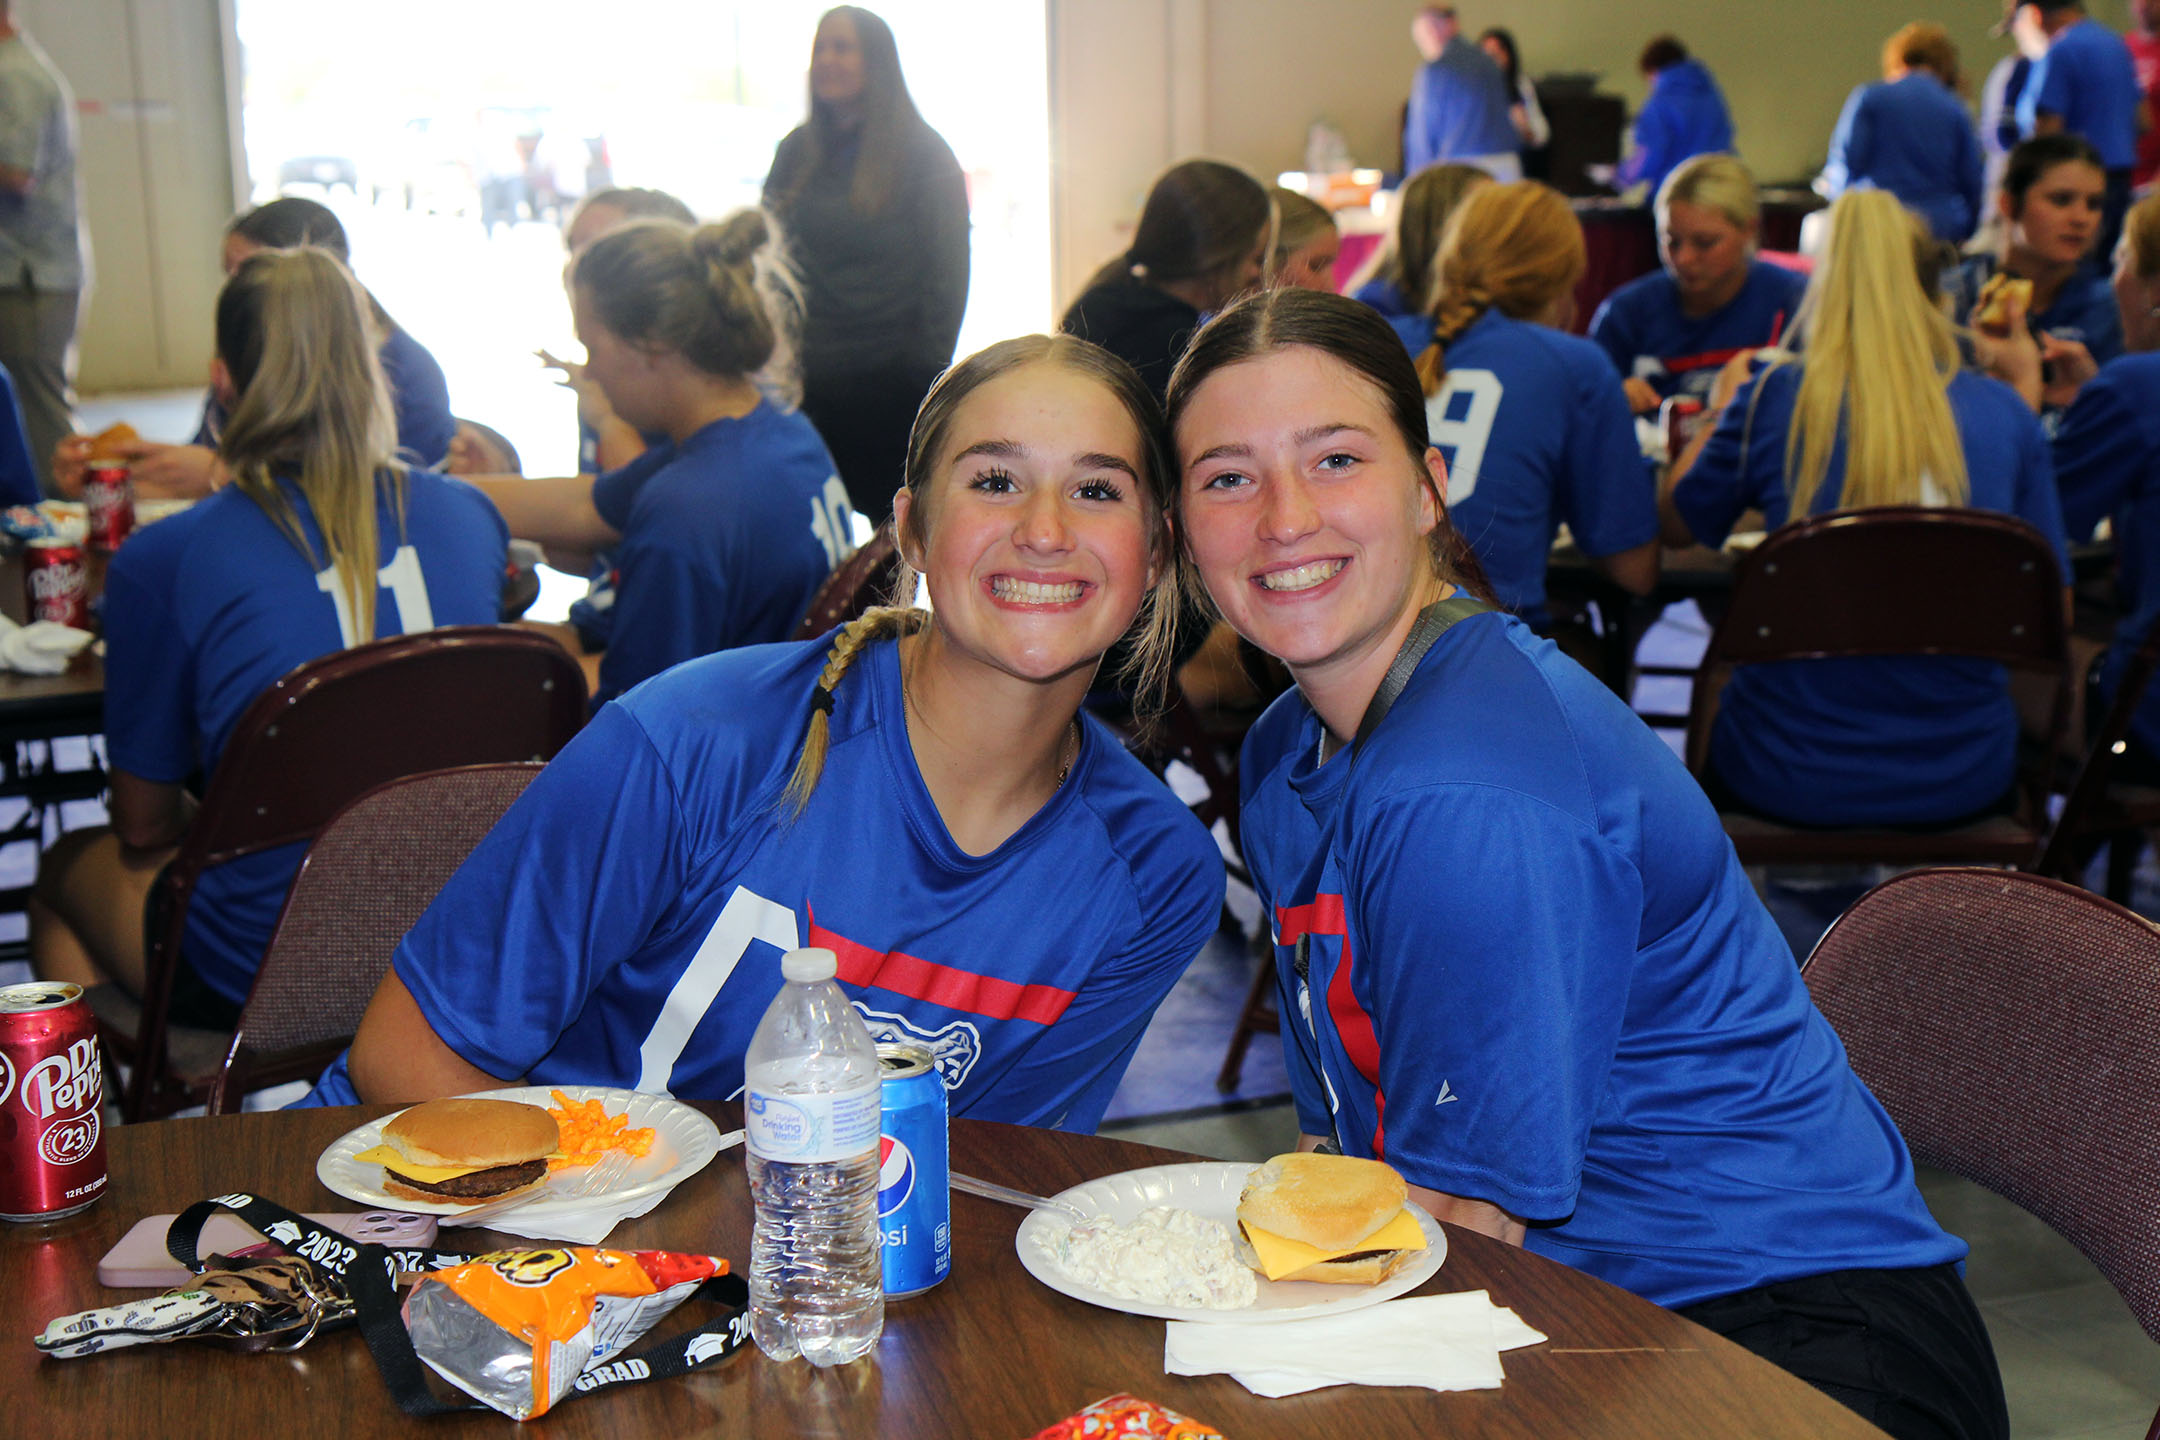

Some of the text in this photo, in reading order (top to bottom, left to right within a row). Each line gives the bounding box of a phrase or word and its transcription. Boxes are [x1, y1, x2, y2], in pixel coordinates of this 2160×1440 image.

[1425, 368, 1504, 509] 9
[316, 545, 435, 651] 11
[68, 1033, 98, 1080] Dr
[60, 1126, 86, 1153] 23
[762, 1118, 802, 1134] Drinking
[65, 1190, 76, 1199] 12
[75, 1187, 85, 1197] FL
[84, 1183, 93, 1193] OZ
[296, 1230, 358, 1276] 2023
[573, 1357, 651, 1392] GRAD
